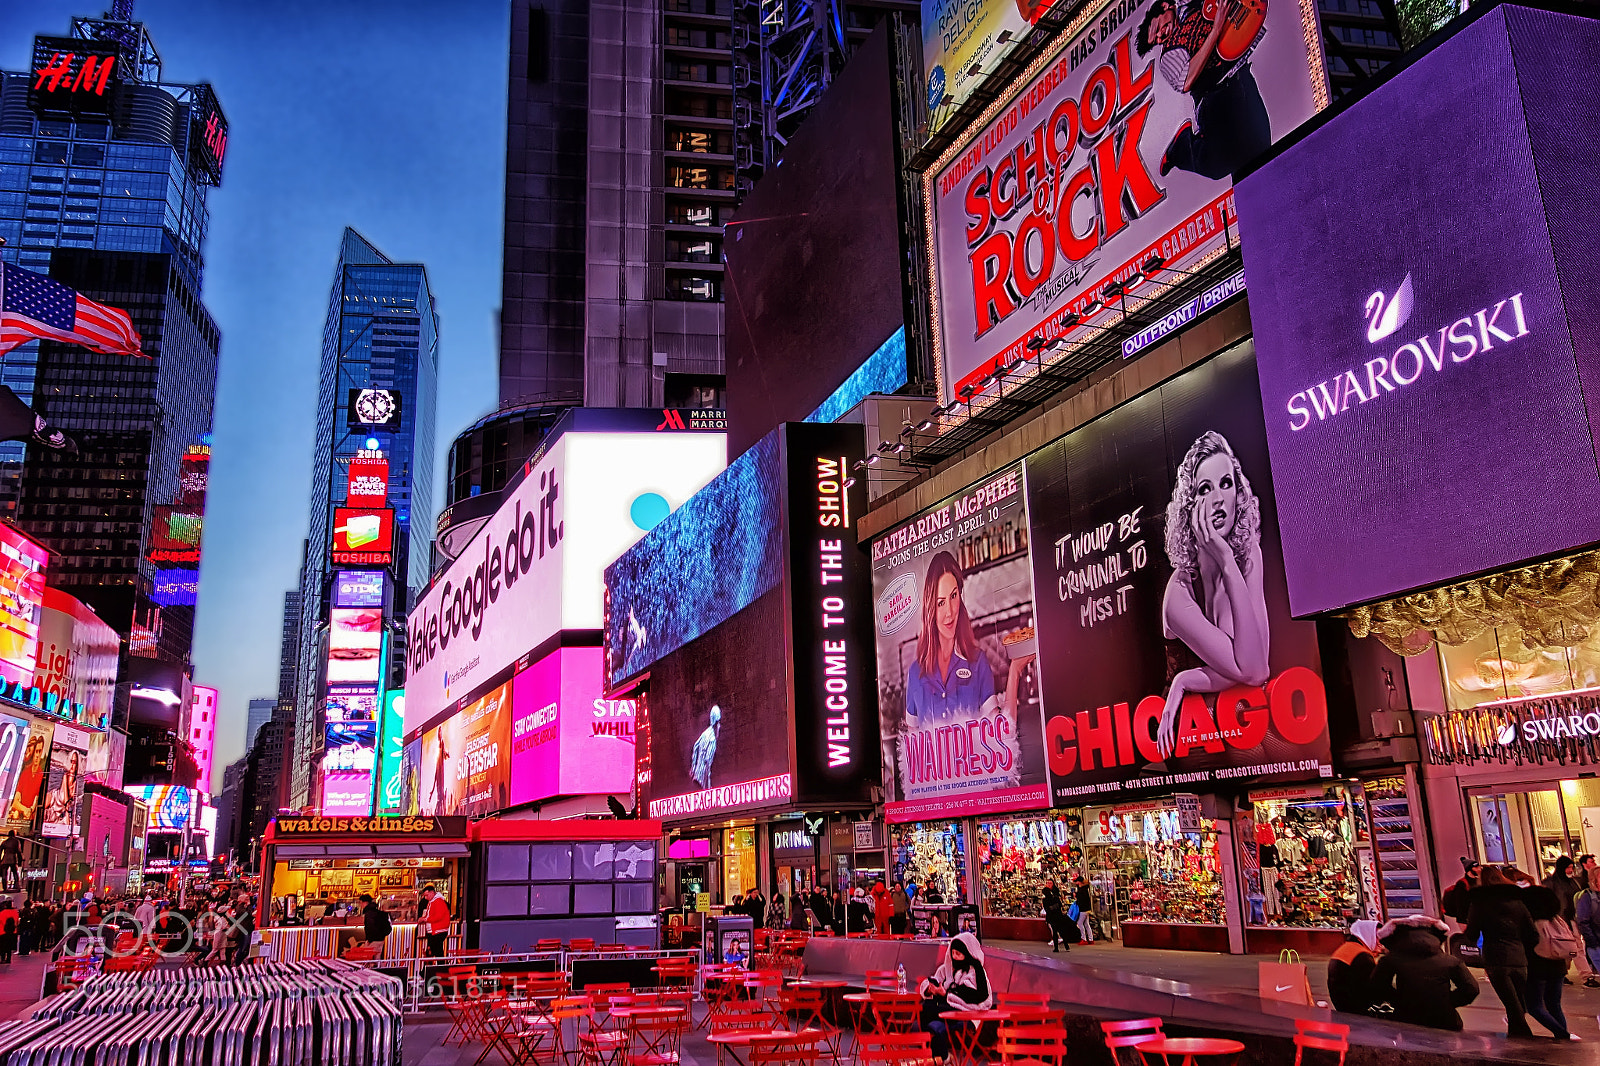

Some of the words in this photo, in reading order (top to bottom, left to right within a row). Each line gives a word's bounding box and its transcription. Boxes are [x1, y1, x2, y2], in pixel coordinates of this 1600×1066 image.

[34, 52, 115, 95] H&M
[984, 106, 1018, 157] LLOYD
[1019, 57, 1068, 120] WEBBER
[1070, 28, 1097, 72] HAS
[204, 110, 227, 169] H&M
[964, 28, 1156, 248] SCHOOL
[1032, 154, 1067, 222] of
[968, 97, 1167, 341] ROCK
[1161, 208, 1215, 262] GARDEN
[1044, 266, 1080, 303] MUSICAL
[1286, 292, 1530, 431] SWAROVSKI
[357, 450, 383, 458] 2018
[350, 482, 386, 490] POWER
[817, 457, 840, 527] SHOW
[333, 553, 391, 564] TOSHIBA
[873, 505, 951, 562] KATHARINE
[888, 550, 911, 570] JOINS
[913, 541, 929, 556] THE
[931, 528, 954, 549] CAST
[957, 515, 985, 538] APRIL
[988, 506, 999, 523] 10
[1055, 533, 1072, 571] IT
[1072, 521, 1114, 562] WOULD
[1118, 505, 1144, 542] BE
[406, 605, 438, 676] Make
[438, 532, 501, 651] Google
[504, 498, 536, 590] do
[538, 467, 564, 560] it.
[820, 539, 843, 585] THE
[1058, 552, 1130, 602] CRIMINAL
[1127, 540, 1147, 573] TO
[822, 596, 845, 628] TO
[1080, 595, 1113, 628] MISS
[1117, 584, 1135, 616] IT
[526, 702, 558, 733] CONNECTED
[823, 639, 850, 768] WELCOME
[1046, 666, 1328, 777] CHICAGO
[1522, 711, 1600, 741] SWARO
[904, 714, 1013, 784] WAITRESS
[1181, 735, 1199, 744] THE
[1200, 728, 1243, 742] MUSICAL
[650, 793, 692, 819] AMERICAN
[693, 787, 721, 812] EAGLE
[723, 774, 791, 808] OUTFITTERS
[1096, 781, 1121, 793] THEATRE
[1125, 779, 1142, 790] 49TH
[1142, 775, 1165, 787] STREET
[1166, 775, 1174, 785] AT
[1174, 770, 1211, 784] BROADWAY
[1215, 759, 1319, 780] CHICAGOTHEMUSICAL.COM
[1002, 820, 1066, 849] GRAND
